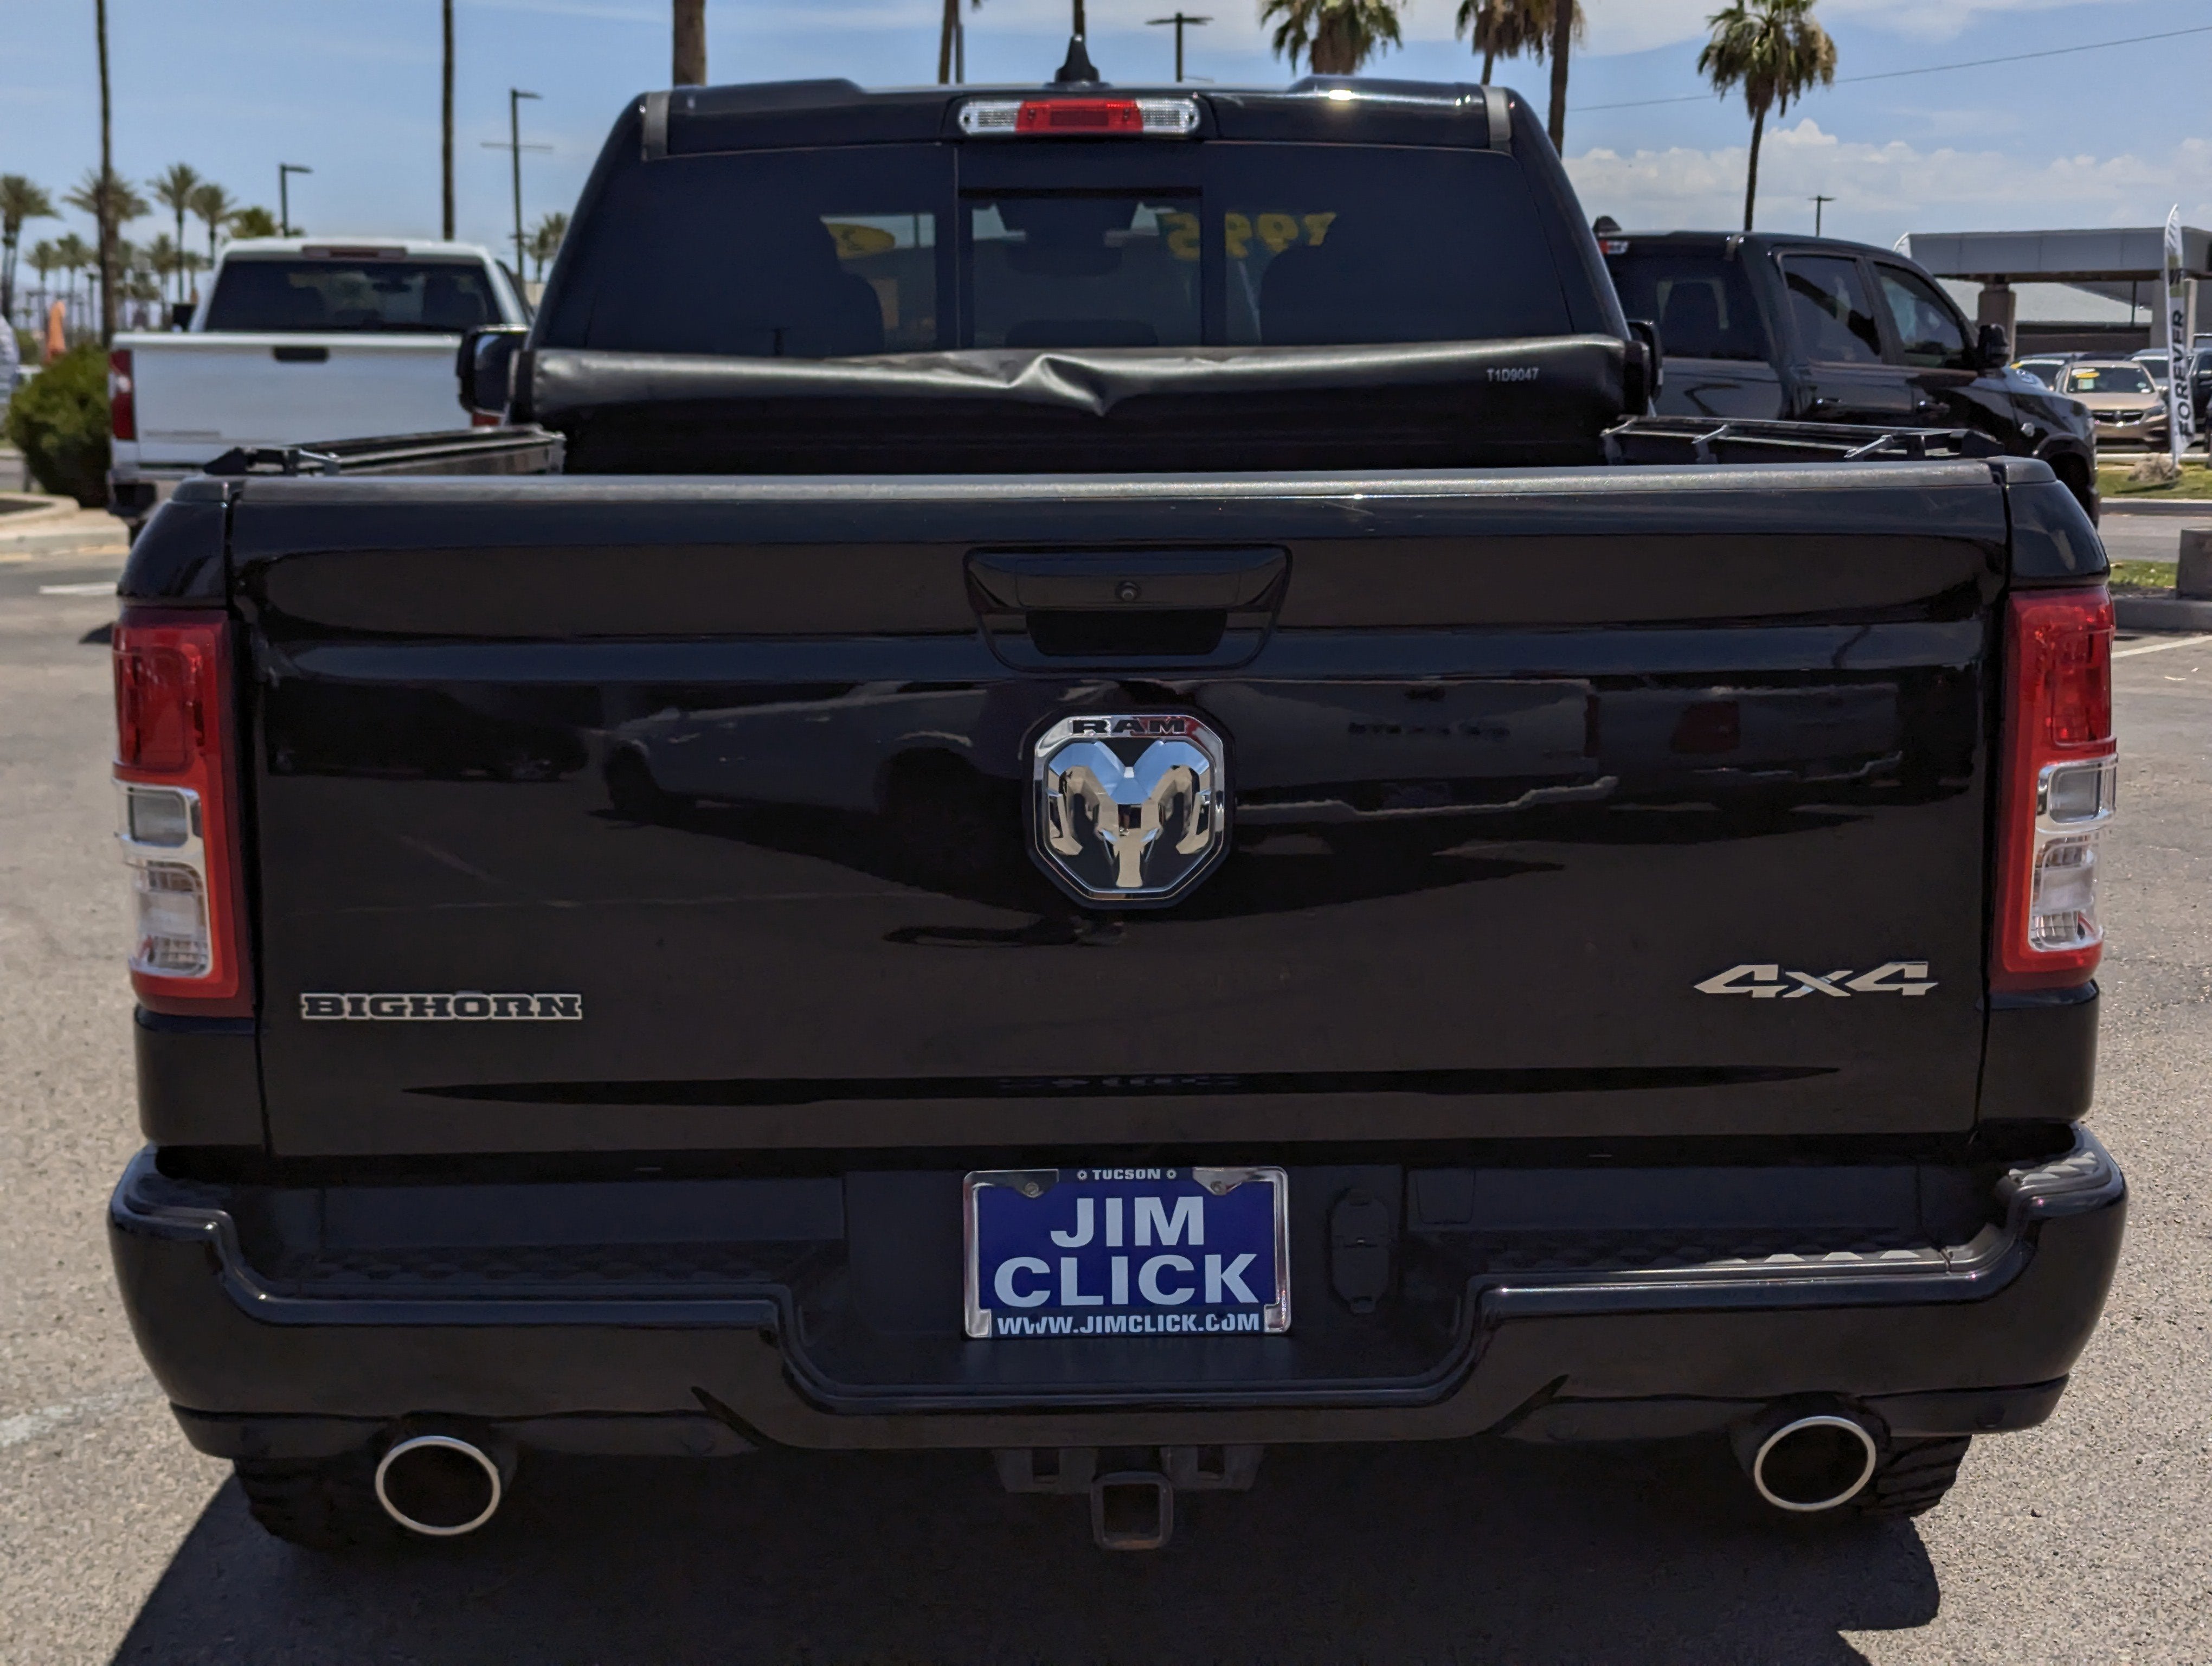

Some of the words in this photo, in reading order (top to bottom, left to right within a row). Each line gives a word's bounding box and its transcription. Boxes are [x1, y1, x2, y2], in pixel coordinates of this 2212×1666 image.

[1486, 366, 1539, 382] T1D9047
[2172, 309, 2195, 437] FOREVER
[1072, 719, 1186, 734] RAM
[300, 992, 583, 1020] BIGHORN
[1092, 1169, 1161, 1181] TUCSON
[1050, 1196, 1204, 1248] JIM
[993, 1253, 1259, 1308] CLICK
[996, 1312, 1260, 1335] WWW.JIMCLICK.COM
